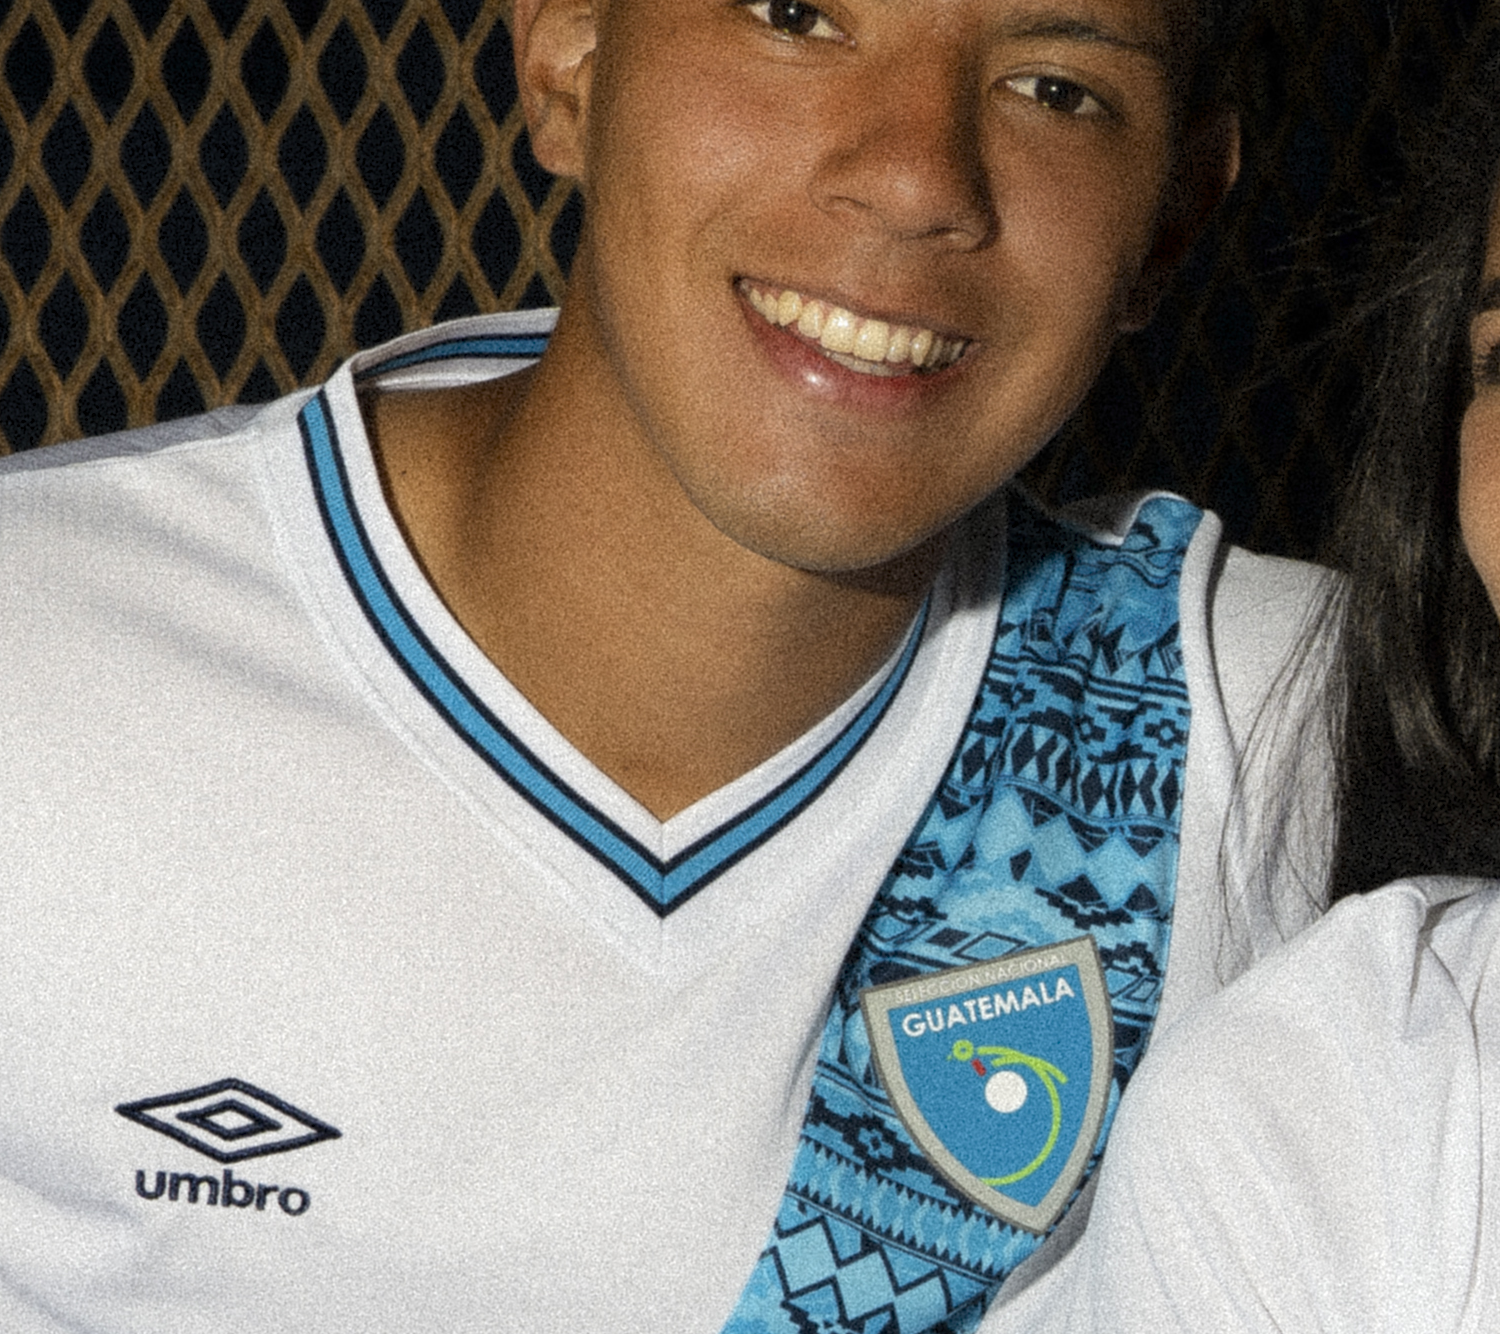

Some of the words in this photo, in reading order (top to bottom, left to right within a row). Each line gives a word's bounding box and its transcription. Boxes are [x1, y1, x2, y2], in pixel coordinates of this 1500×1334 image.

[984, 953, 1067, 981] NACIONAL
[902, 977, 1075, 1037] GUATEMALA
[135, 1169, 311, 1216] umbro
